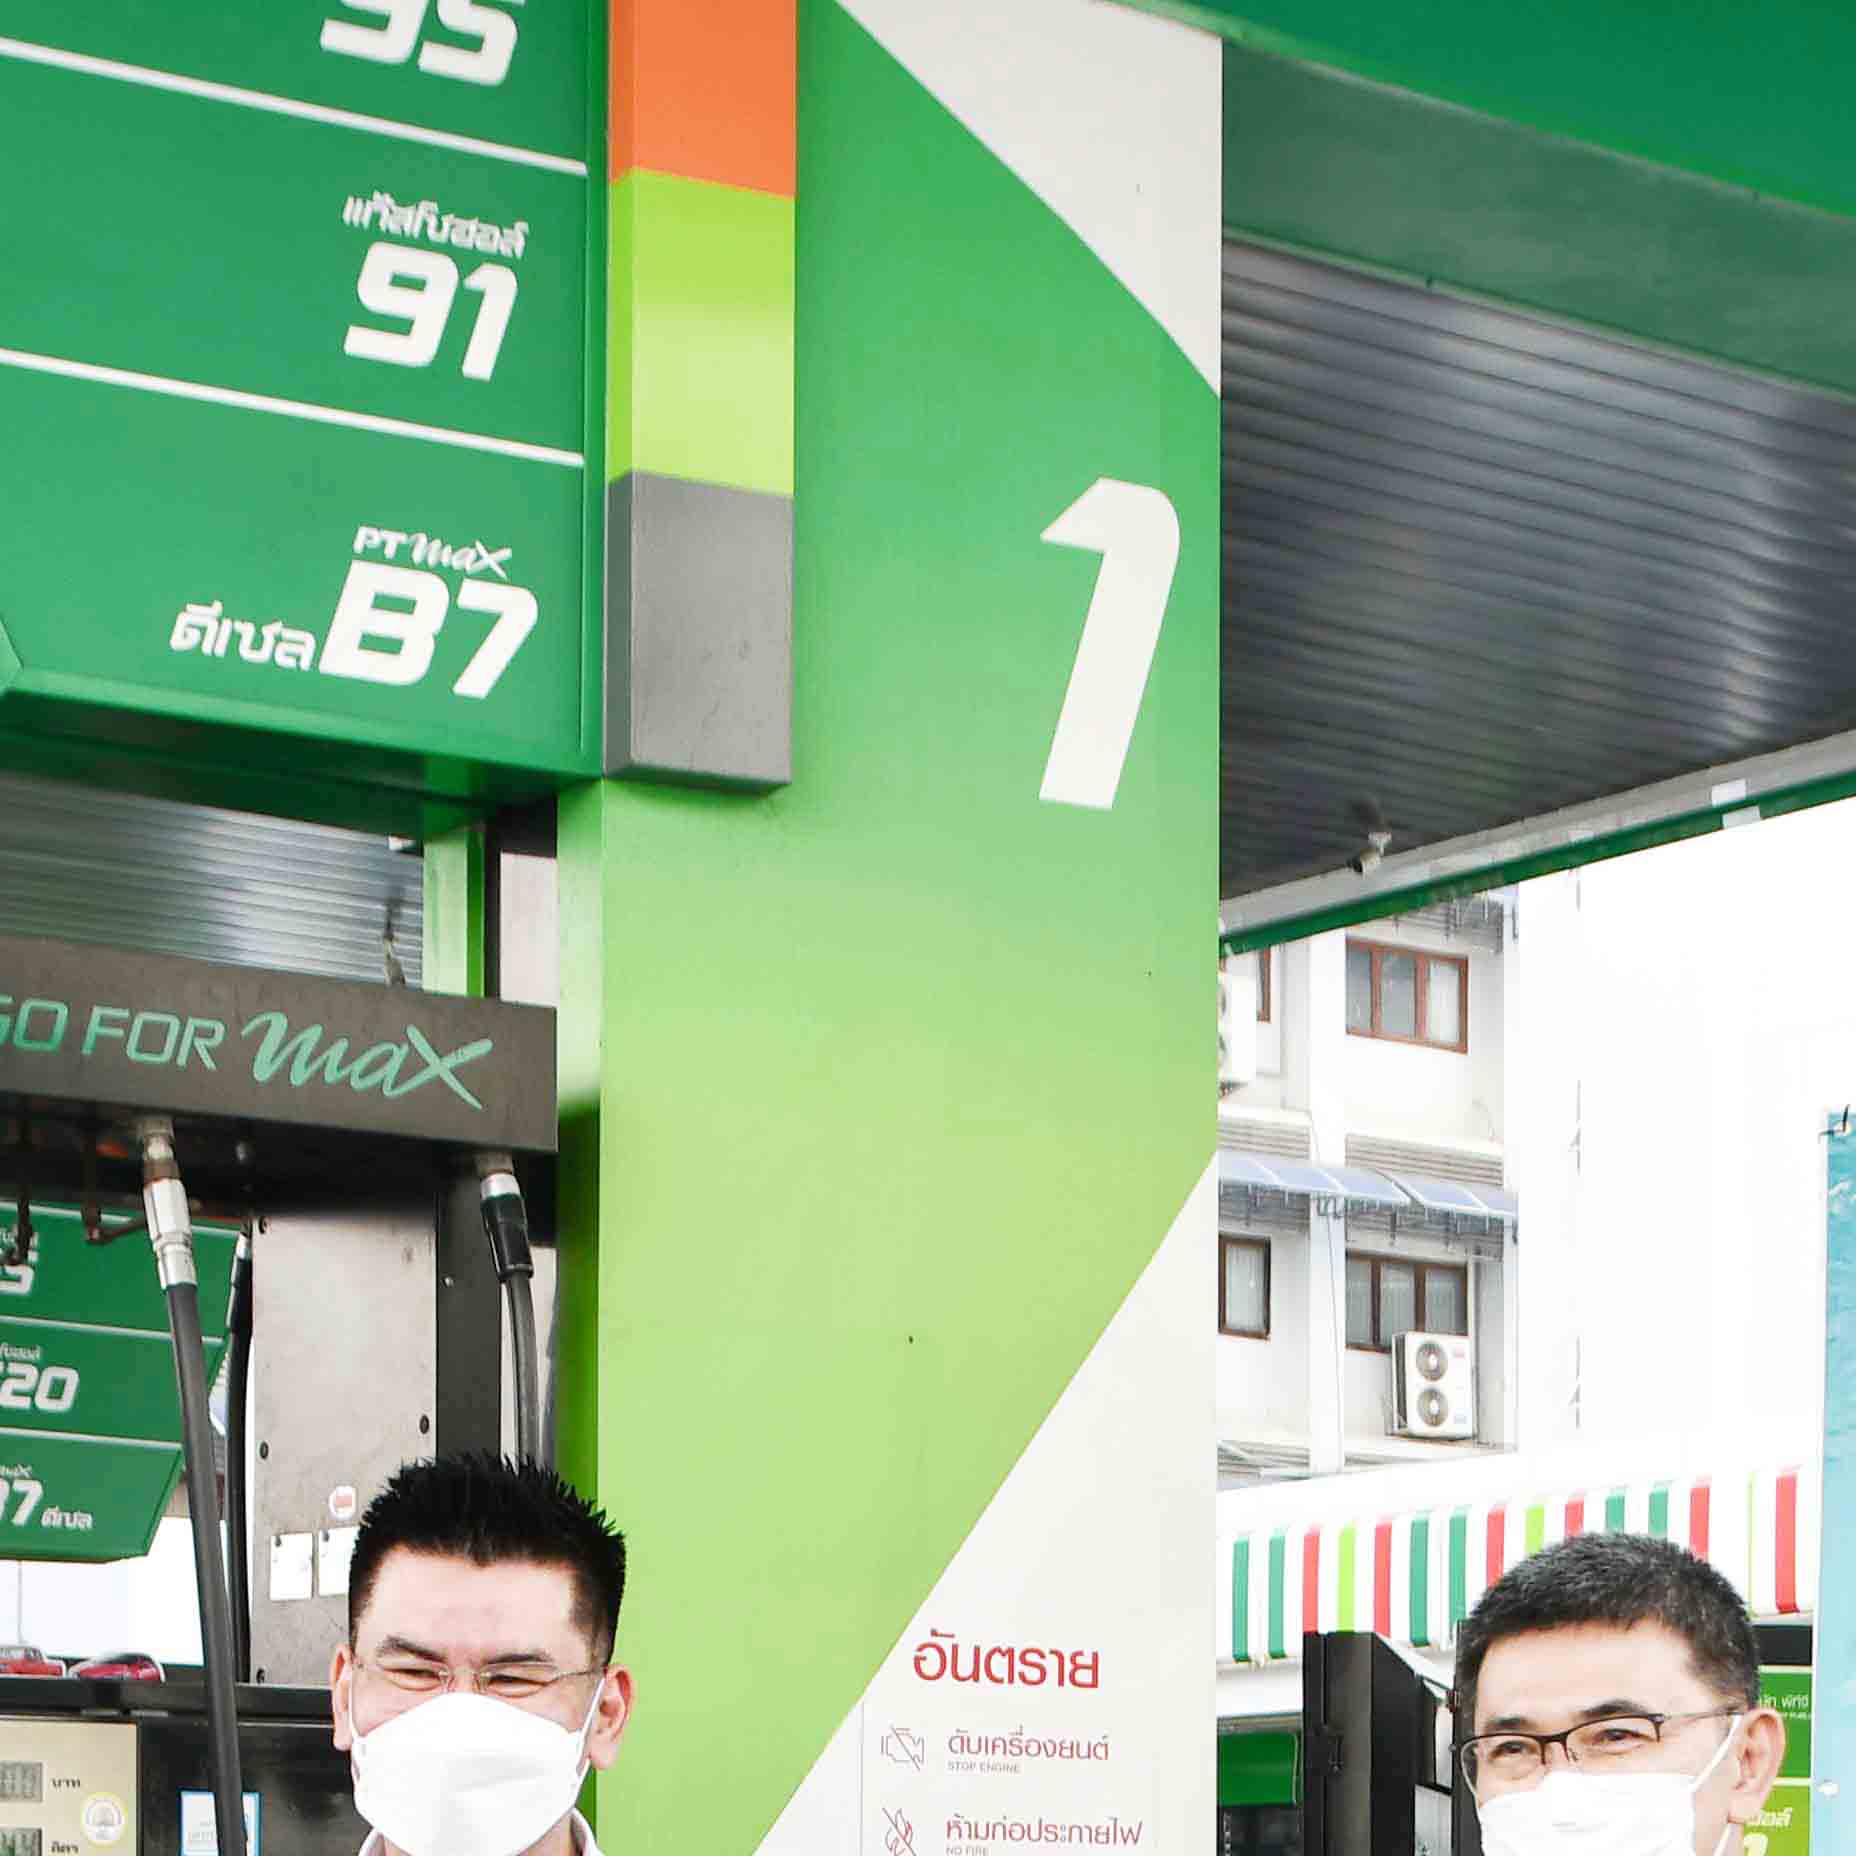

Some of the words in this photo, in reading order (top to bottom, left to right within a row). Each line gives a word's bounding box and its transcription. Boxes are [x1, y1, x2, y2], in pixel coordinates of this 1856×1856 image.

[344, 240, 518, 381] 91
[353, 525, 403, 556] PT
[170, 601, 316, 671] ดีเซล
[318, 559, 539, 699] B7
[1039, 475, 1181, 811] 1
[81, 1005, 227, 1072] FOR
[913, 1628, 1101, 1690] อันตราย
[947, 1724, 1110, 1761] ดับเครื่องยนต์
[947, 1760, 977, 1772] STOP
[945, 1812, 1143, 1847] ห้ามก่อประกายไฟ
